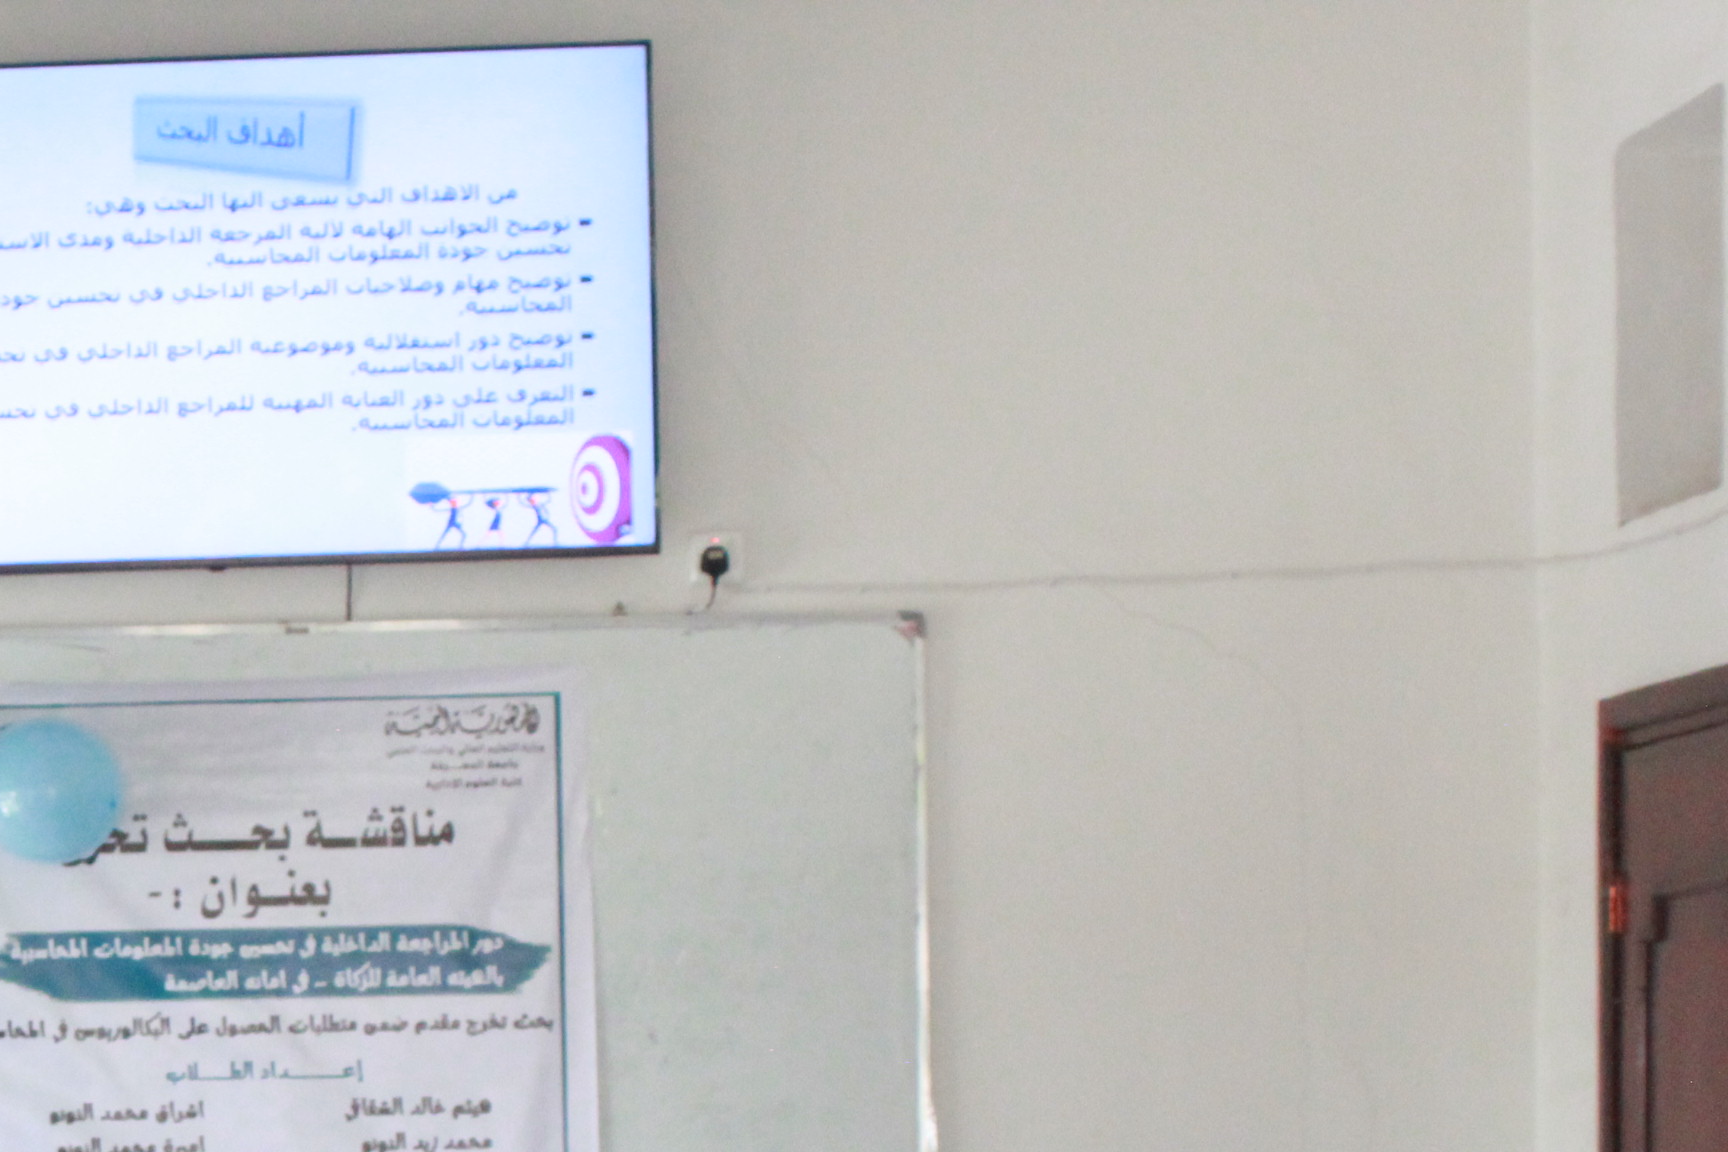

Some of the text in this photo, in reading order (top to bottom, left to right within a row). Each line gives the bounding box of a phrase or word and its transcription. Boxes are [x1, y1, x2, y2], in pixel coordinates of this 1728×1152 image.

[157, 111, 304, 148] أهداف البحث
[154, 193, 214, 213] البحث
[487, 187, 518, 205] من
[122, 226, 202, 247] الداخلية
[351, 219, 413, 241] الهامة
[420, 216, 498, 238] الجوانب
[506, 216, 570, 237] توضيح
[327, 242, 430, 266] المعلومات
[437, 243, 488, 263] جودة
[496, 244, 571, 263] تحسين
[262, 278, 338, 303] المراجع
[345, 275, 445, 297] وصلاحيات
[454, 275, 500, 295] مهام
[507, 273, 571, 295] توضيح
[47, 290, 122, 309] تحسين
[167, 338, 243, 363] المراجع
[467, 333, 501, 352] دور
[508, 330, 572, 351] توضيح
[471, 352, 574, 375] المعلومات
[261, 393, 333, 414] المهنية
[341, 390, 405, 410] العناية
[411, 393, 445, 412] دور
[506, 384, 574, 405] التعرف
[177, 394, 254, 419] للمراجع
[471, 409, 574, 431] المعلومات
[302, 804, 455, 848] مناقشة
[164, 813, 290, 862] بحث
[200, 869, 332, 920] بعنوان
[10, 937, 89, 965] المحاسبية
[93, 935, 183, 960] المعلومات
[188, 938, 233, 956] جودة
[239, 938, 295, 959] تحسين
[321, 930, 392, 958] الداخلية
[396, 930, 470, 956] المراجعة
[472, 936, 505, 955] دور
[164, 968, 238, 992] العاصمة
[386, 965, 441, 988] العامة
[215, 1014, 281, 1038] الحصول
[288, 1013, 358, 1036] متطلبات
[364, 1015, 409, 1036] ضمن
[414, 1012, 460, 1035] مقدم
[466, 1012, 508, 1036] تخرج
[513, 1013, 554, 1032] بحث
[100, 1107, 149, 1121] محمد
[409, 1096, 446, 1117] خالد
[452, 1097, 493, 1119] هيثم
[444, 1137, 493, 1150] محمد
